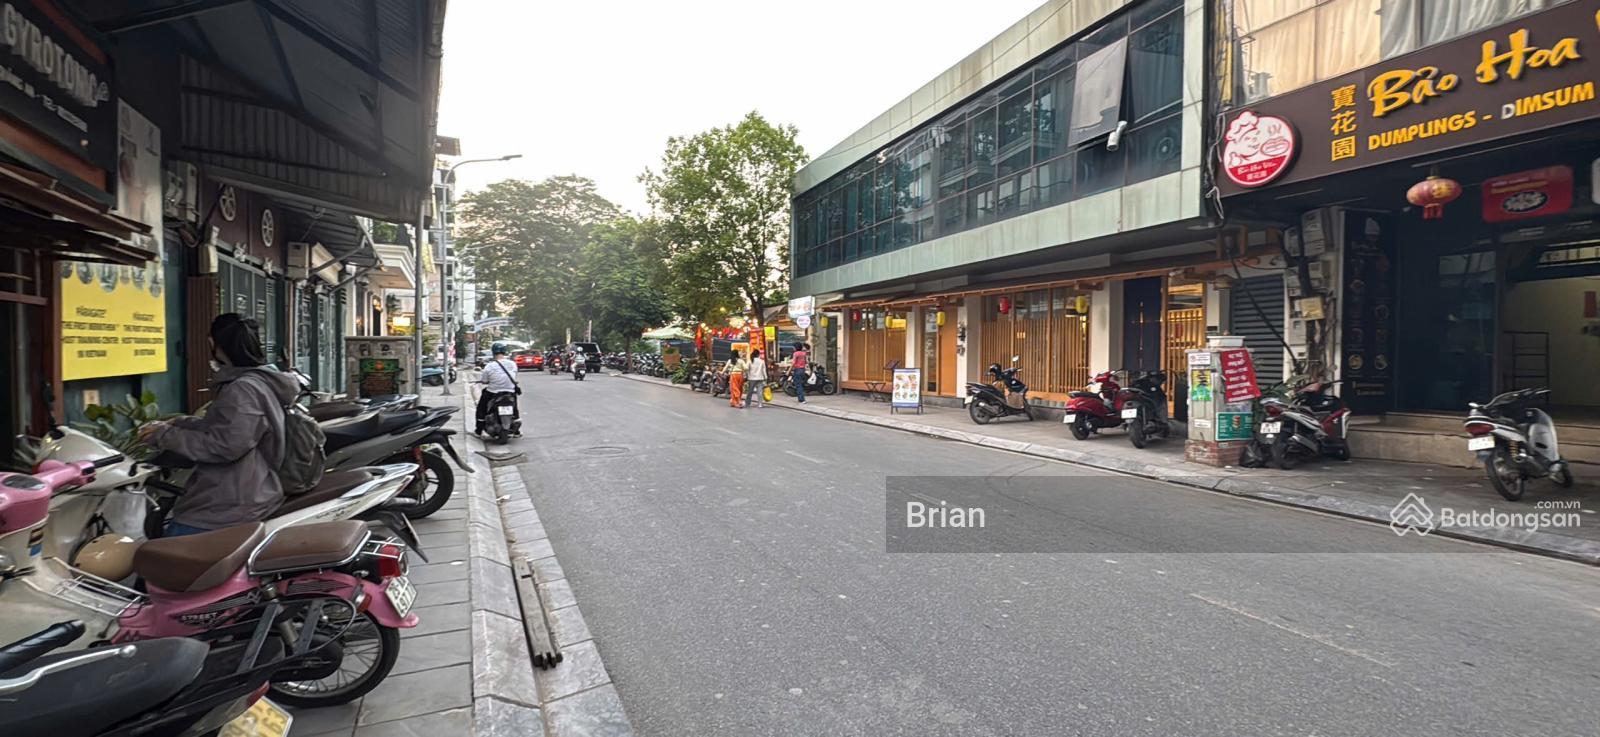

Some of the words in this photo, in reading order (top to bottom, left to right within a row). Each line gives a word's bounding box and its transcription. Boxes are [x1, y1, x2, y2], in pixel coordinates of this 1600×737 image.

[1367, 66, 1459, 117] Bảo
[1475, 28, 1581, 83] Hoa
[1368, 110, 1477, 150] DUMPLINGS
[1501, 81, 1595, 120] DIMSUM
